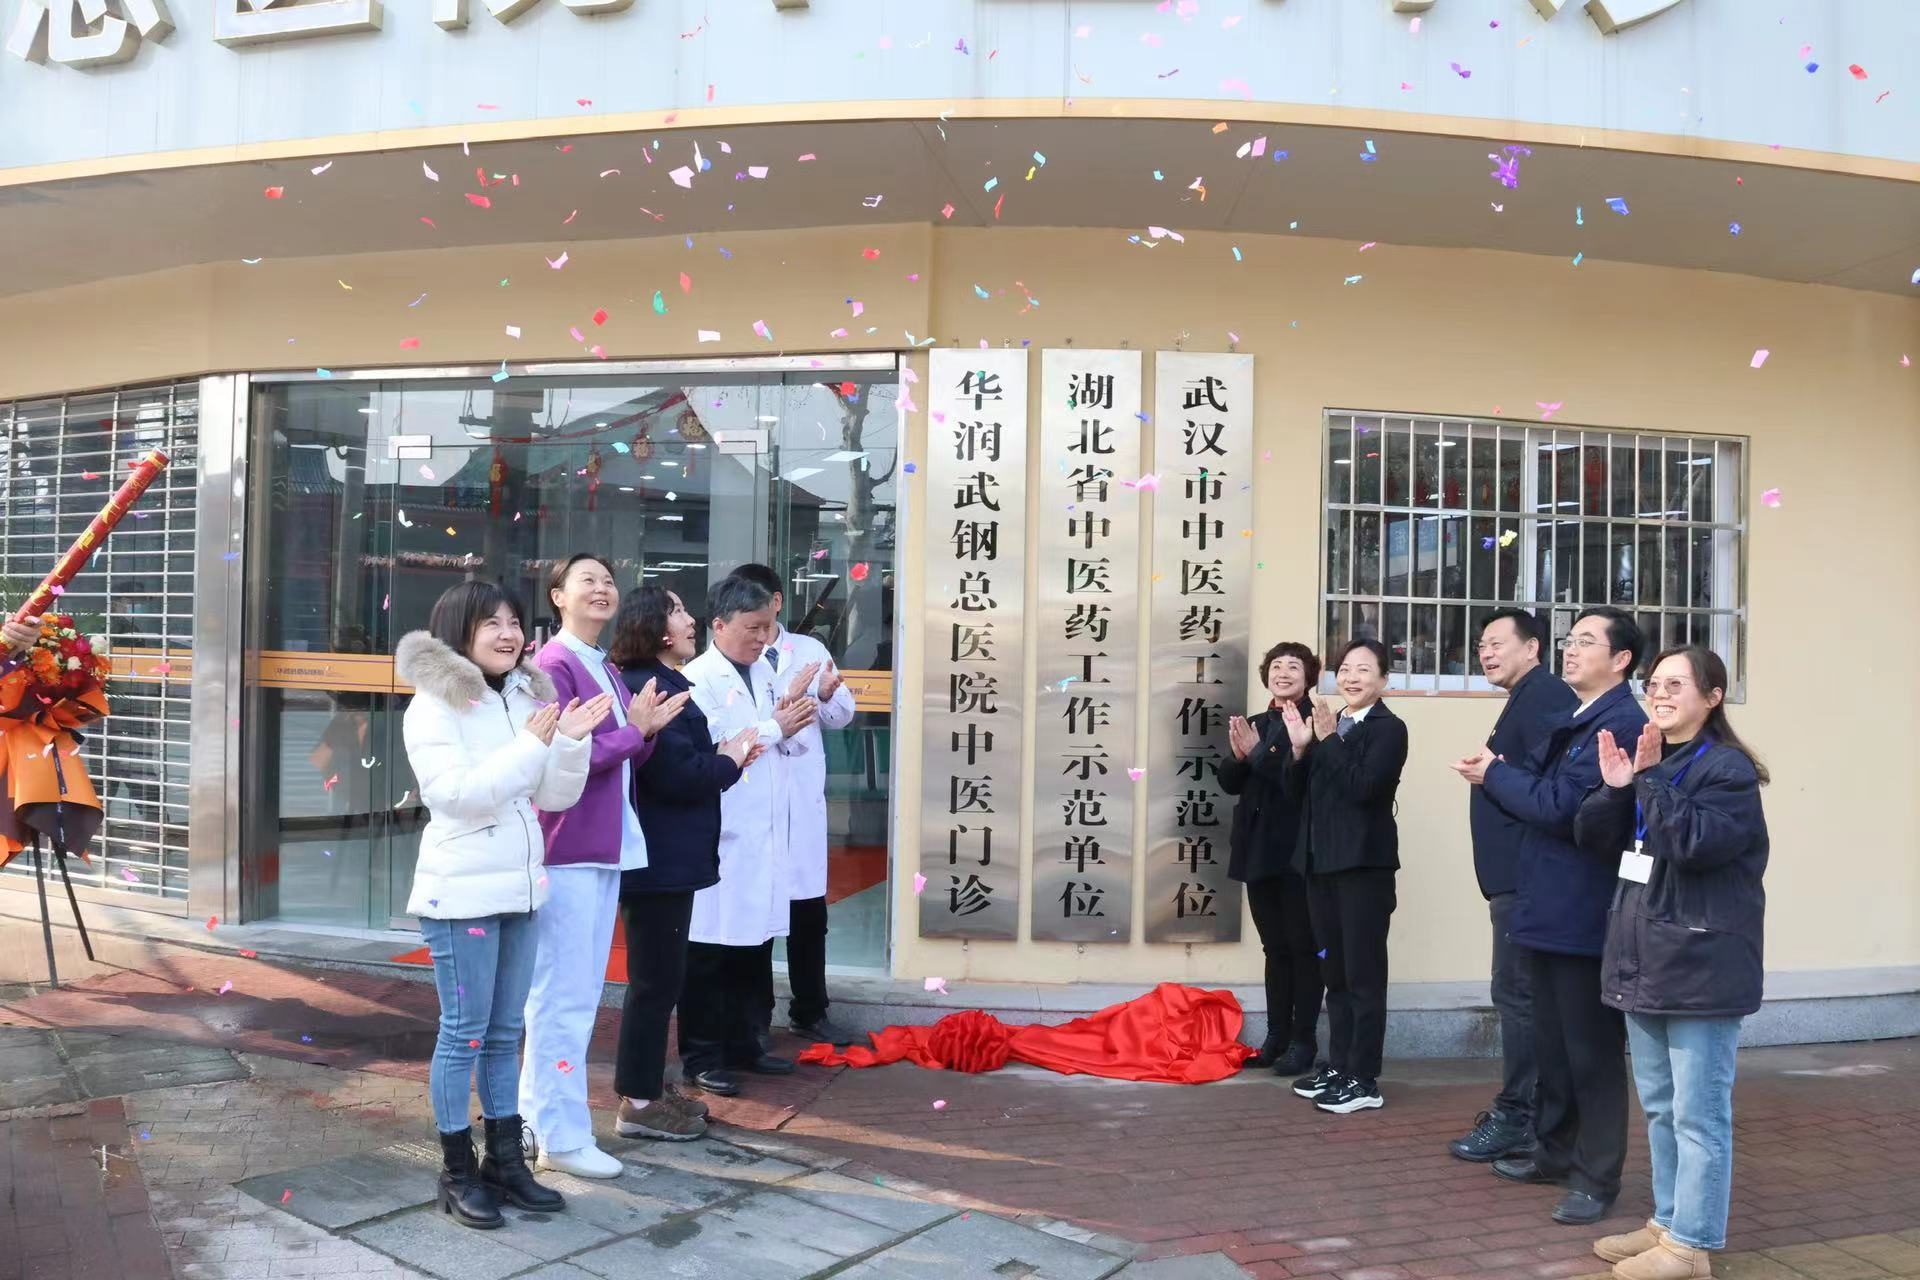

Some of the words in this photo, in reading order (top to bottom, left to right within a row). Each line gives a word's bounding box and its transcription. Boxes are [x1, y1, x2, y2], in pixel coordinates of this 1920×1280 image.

[944, 370, 1003, 917] 华润武钢总医院中医门诊
[1058, 373, 1116, 918] 湖北省中医药工作示范单位
[1171, 376, 1229, 919] 武汉市中医药工作示范单位
